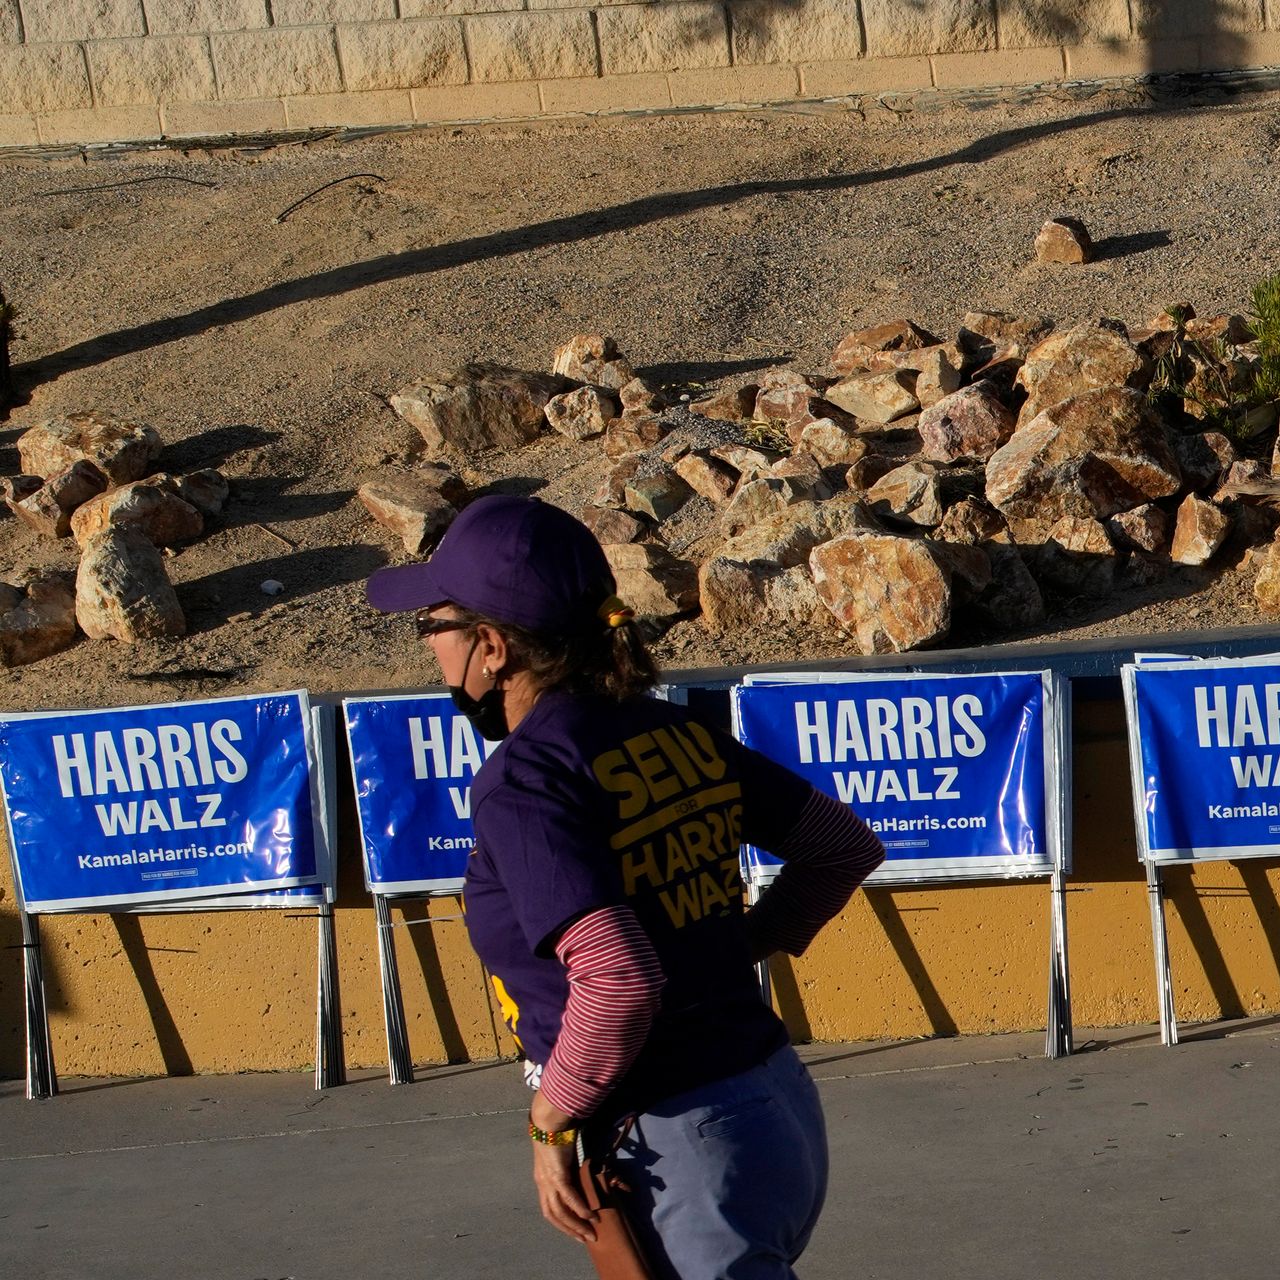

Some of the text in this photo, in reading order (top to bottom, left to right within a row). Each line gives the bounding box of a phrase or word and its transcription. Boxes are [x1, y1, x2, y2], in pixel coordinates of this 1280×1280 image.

[795, 694, 986, 763] HARRIS
[52, 718, 248, 798] HARRIS
[592, 721, 727, 819] SEIU
[833, 767, 960, 803] WALZ
[95, 794, 226, 836] WALZ
[866, 815, 986, 832] laHarris.com
[78, 843, 254, 870] KamalaHarris.com
